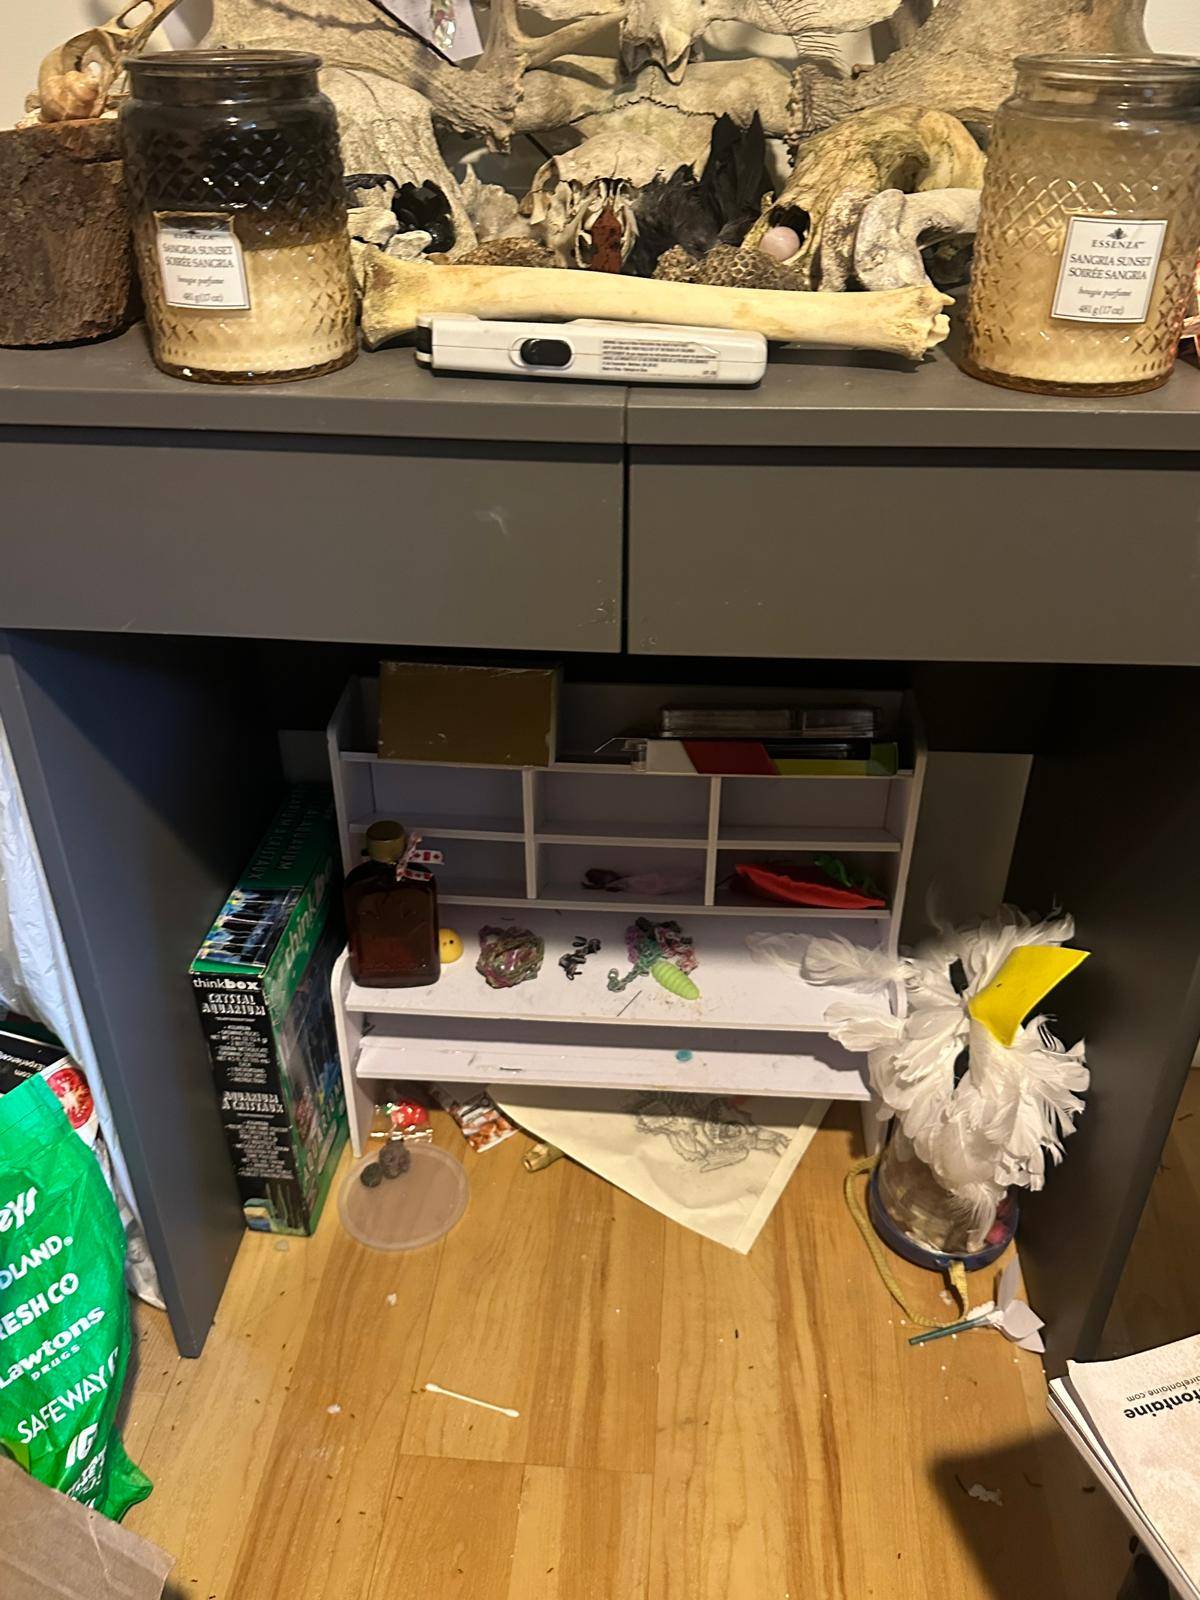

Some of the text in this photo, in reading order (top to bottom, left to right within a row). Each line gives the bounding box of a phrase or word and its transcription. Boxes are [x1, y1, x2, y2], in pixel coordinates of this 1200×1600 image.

[1091, 240, 1140, 249] ESSENZA
[1069, 253, 1152, 266] SANGRIA SUNSET
[1105, 270, 1147, 280] SANGRIA
[193, 978, 261, 990] thinkbox
[202, 1003, 266, 1016] AQUARIUM
[31, 1344, 80, 1381] DRUGS
[17, 1365, 108, 1444] SAFEWAY
